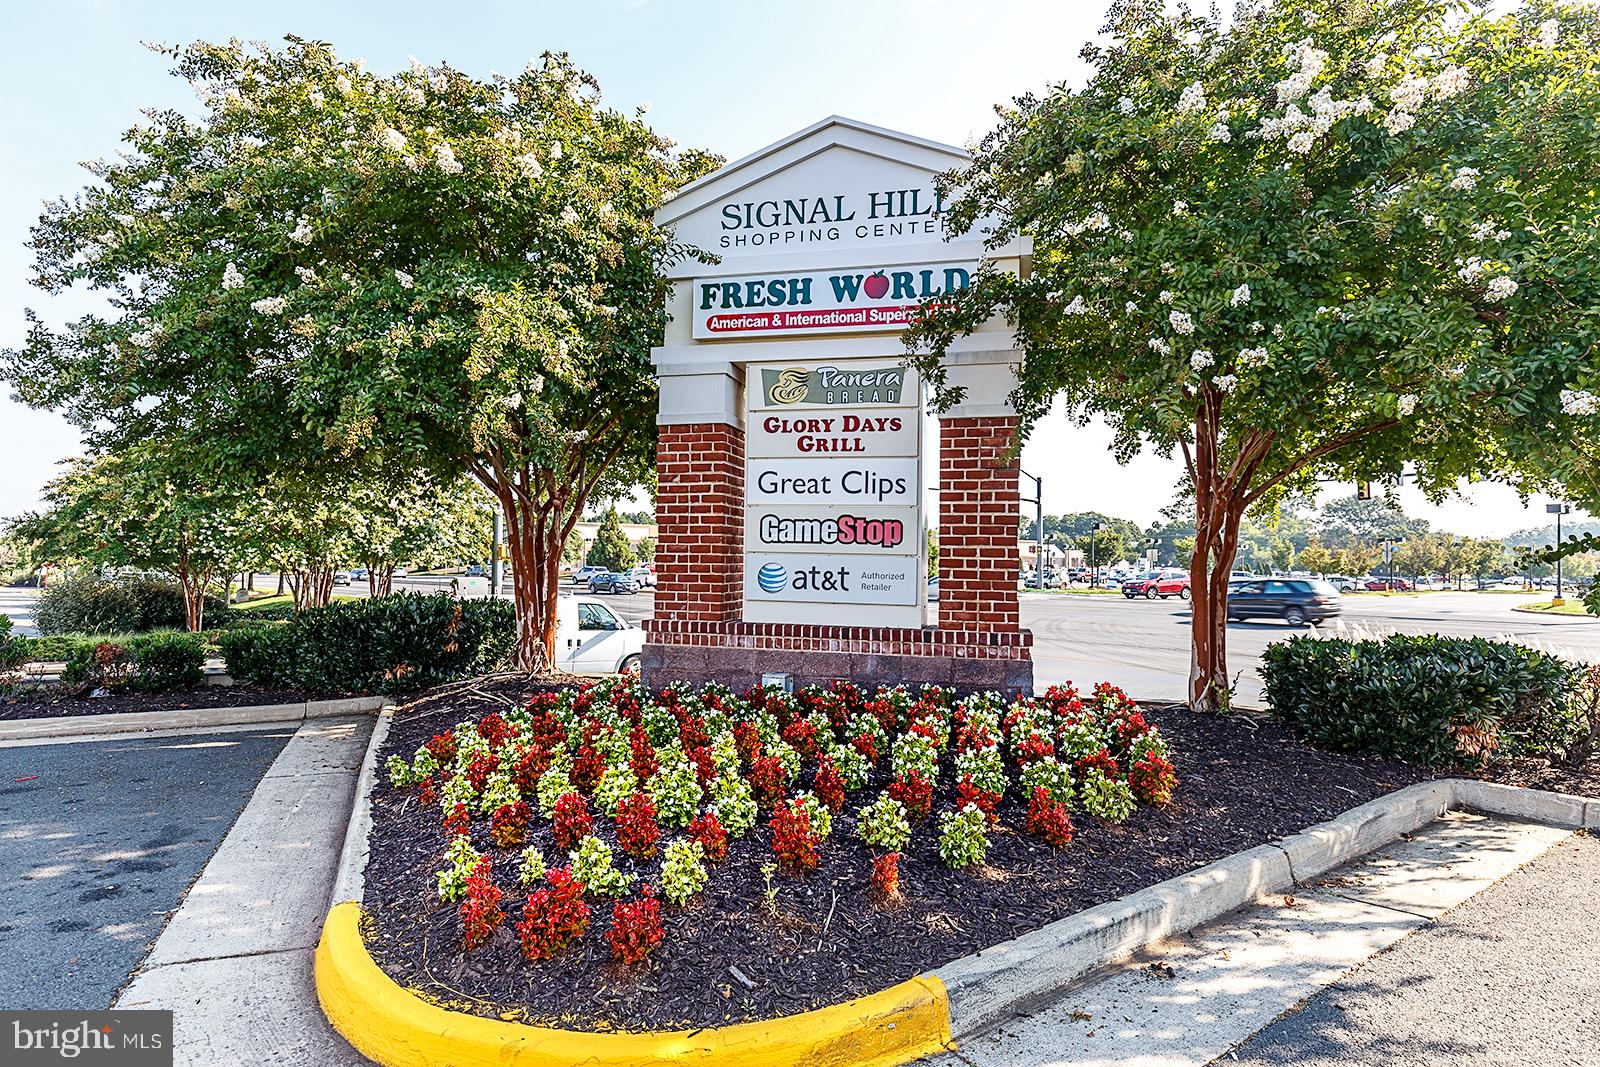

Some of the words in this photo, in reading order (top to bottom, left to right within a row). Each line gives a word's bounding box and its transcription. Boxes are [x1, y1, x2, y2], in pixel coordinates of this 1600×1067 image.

[721, 195, 856, 230] SIGNAL
[867, 187, 954, 220] HILL
[720, 227, 841, 248] SHOPPING
[700, 277, 813, 310] FRESH
[829, 267, 970, 303] WORLD
[710, 315, 768, 330] American
[771, 313, 782, 327] &
[785, 309, 866, 326] International
[816, 366, 900, 389] Panera
[826, 390, 895, 404] BREAD
[763, 416, 835, 433] GLORY
[841, 415, 902, 433] DAYS
[797, 435, 866, 452] GRILL
[757, 470, 831, 495] Great
[841, 470, 907, 501] Clips
[759, 513, 904, 548] GameStop
[791, 565, 850, 592] at&t
[860, 571, 905, 581] Authorized
[860, 583, 893, 592] Retailer
